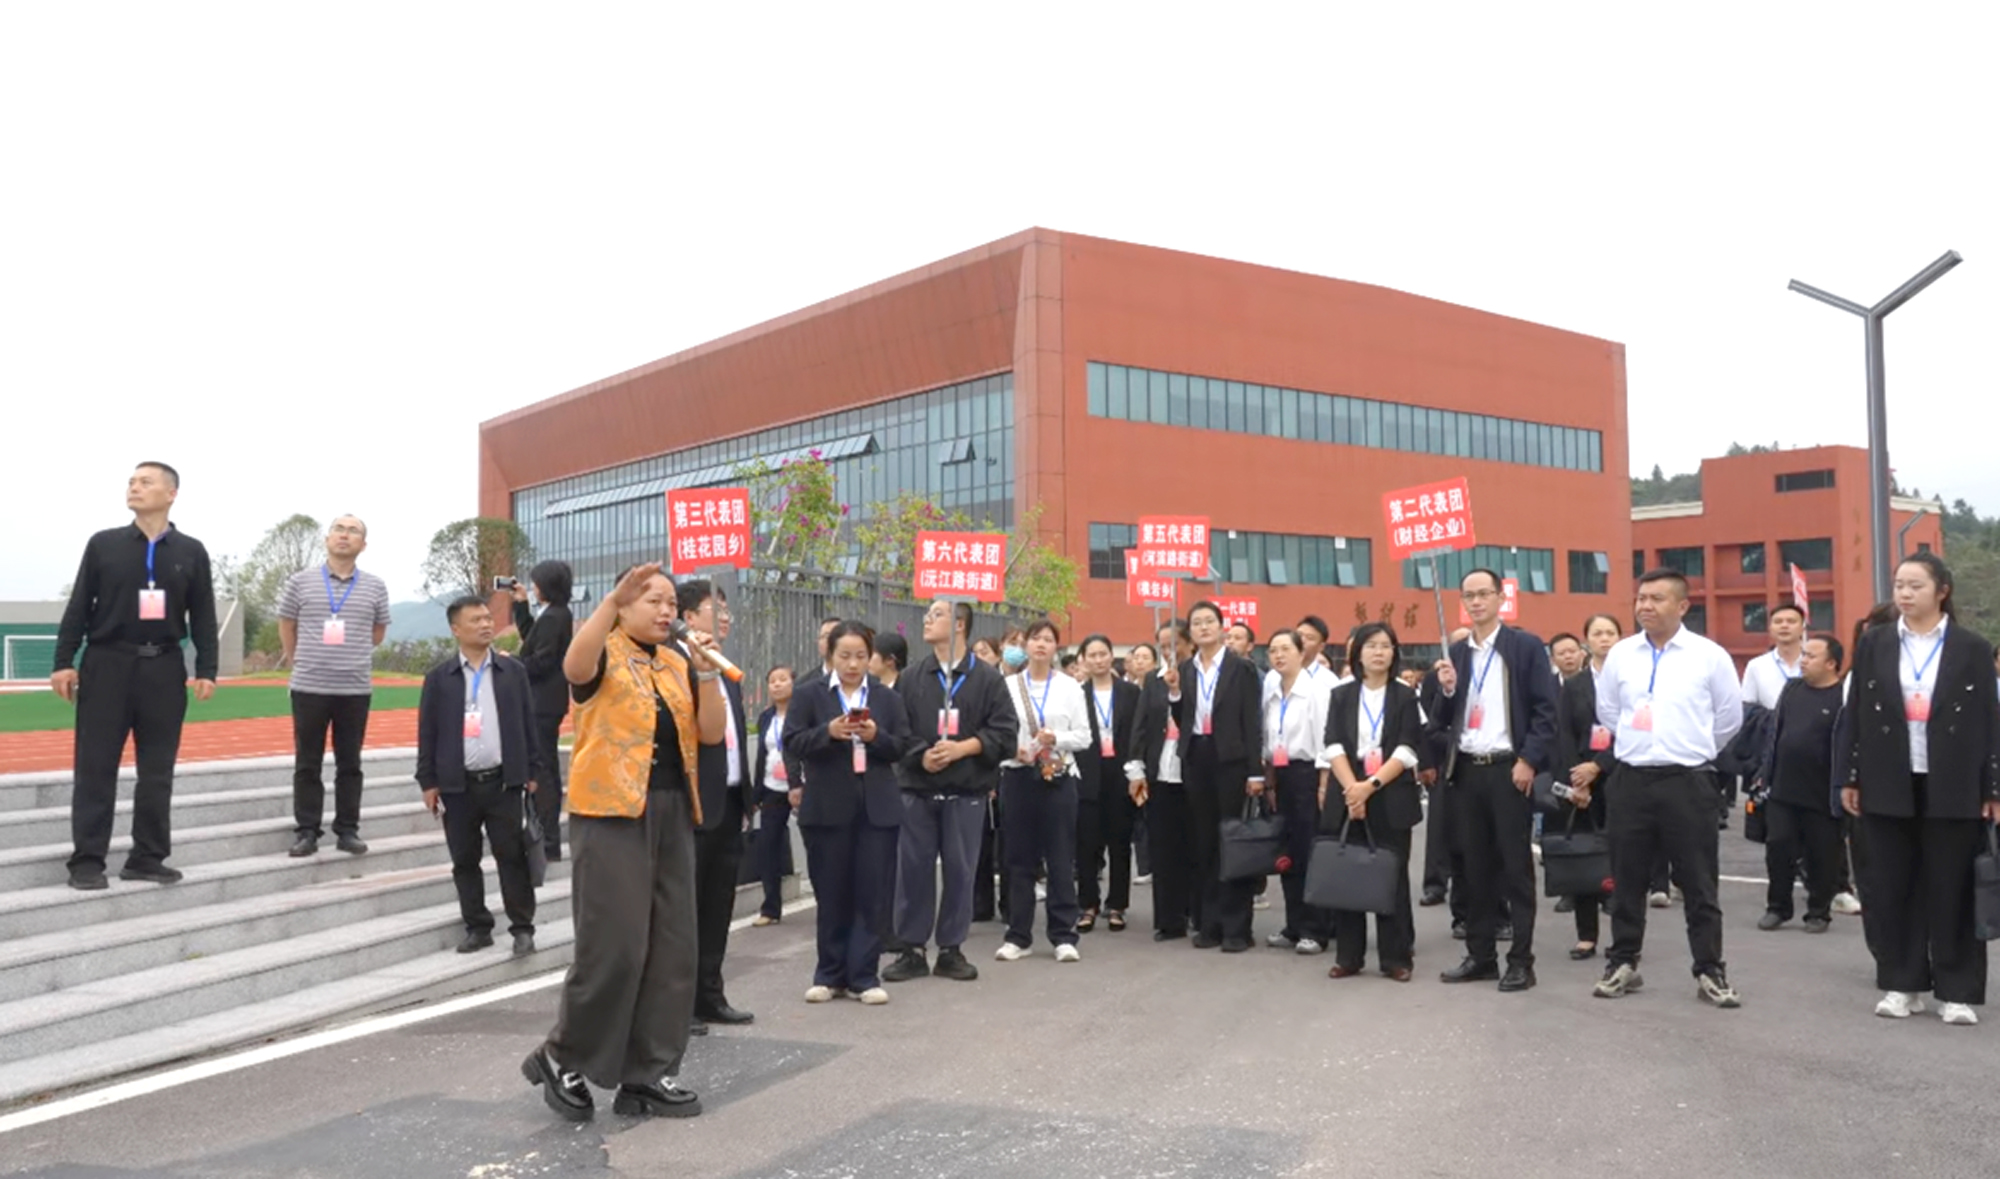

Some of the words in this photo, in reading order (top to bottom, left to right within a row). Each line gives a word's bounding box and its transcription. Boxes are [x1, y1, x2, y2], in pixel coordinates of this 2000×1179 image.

[673, 498, 745, 529] 第三代表团
[1389, 487, 1464, 524] 第二代表团
[1142, 524, 1206, 545] 第五代表团
[1393, 517, 1466, 547] (财经企业)
[676, 532, 745, 560] (桂花园乡)
[922, 539, 1000, 566] 第六代表团
[920, 569, 998, 591] (沅江路街道)
[1213, 601, 1257, 616] 一代表团
